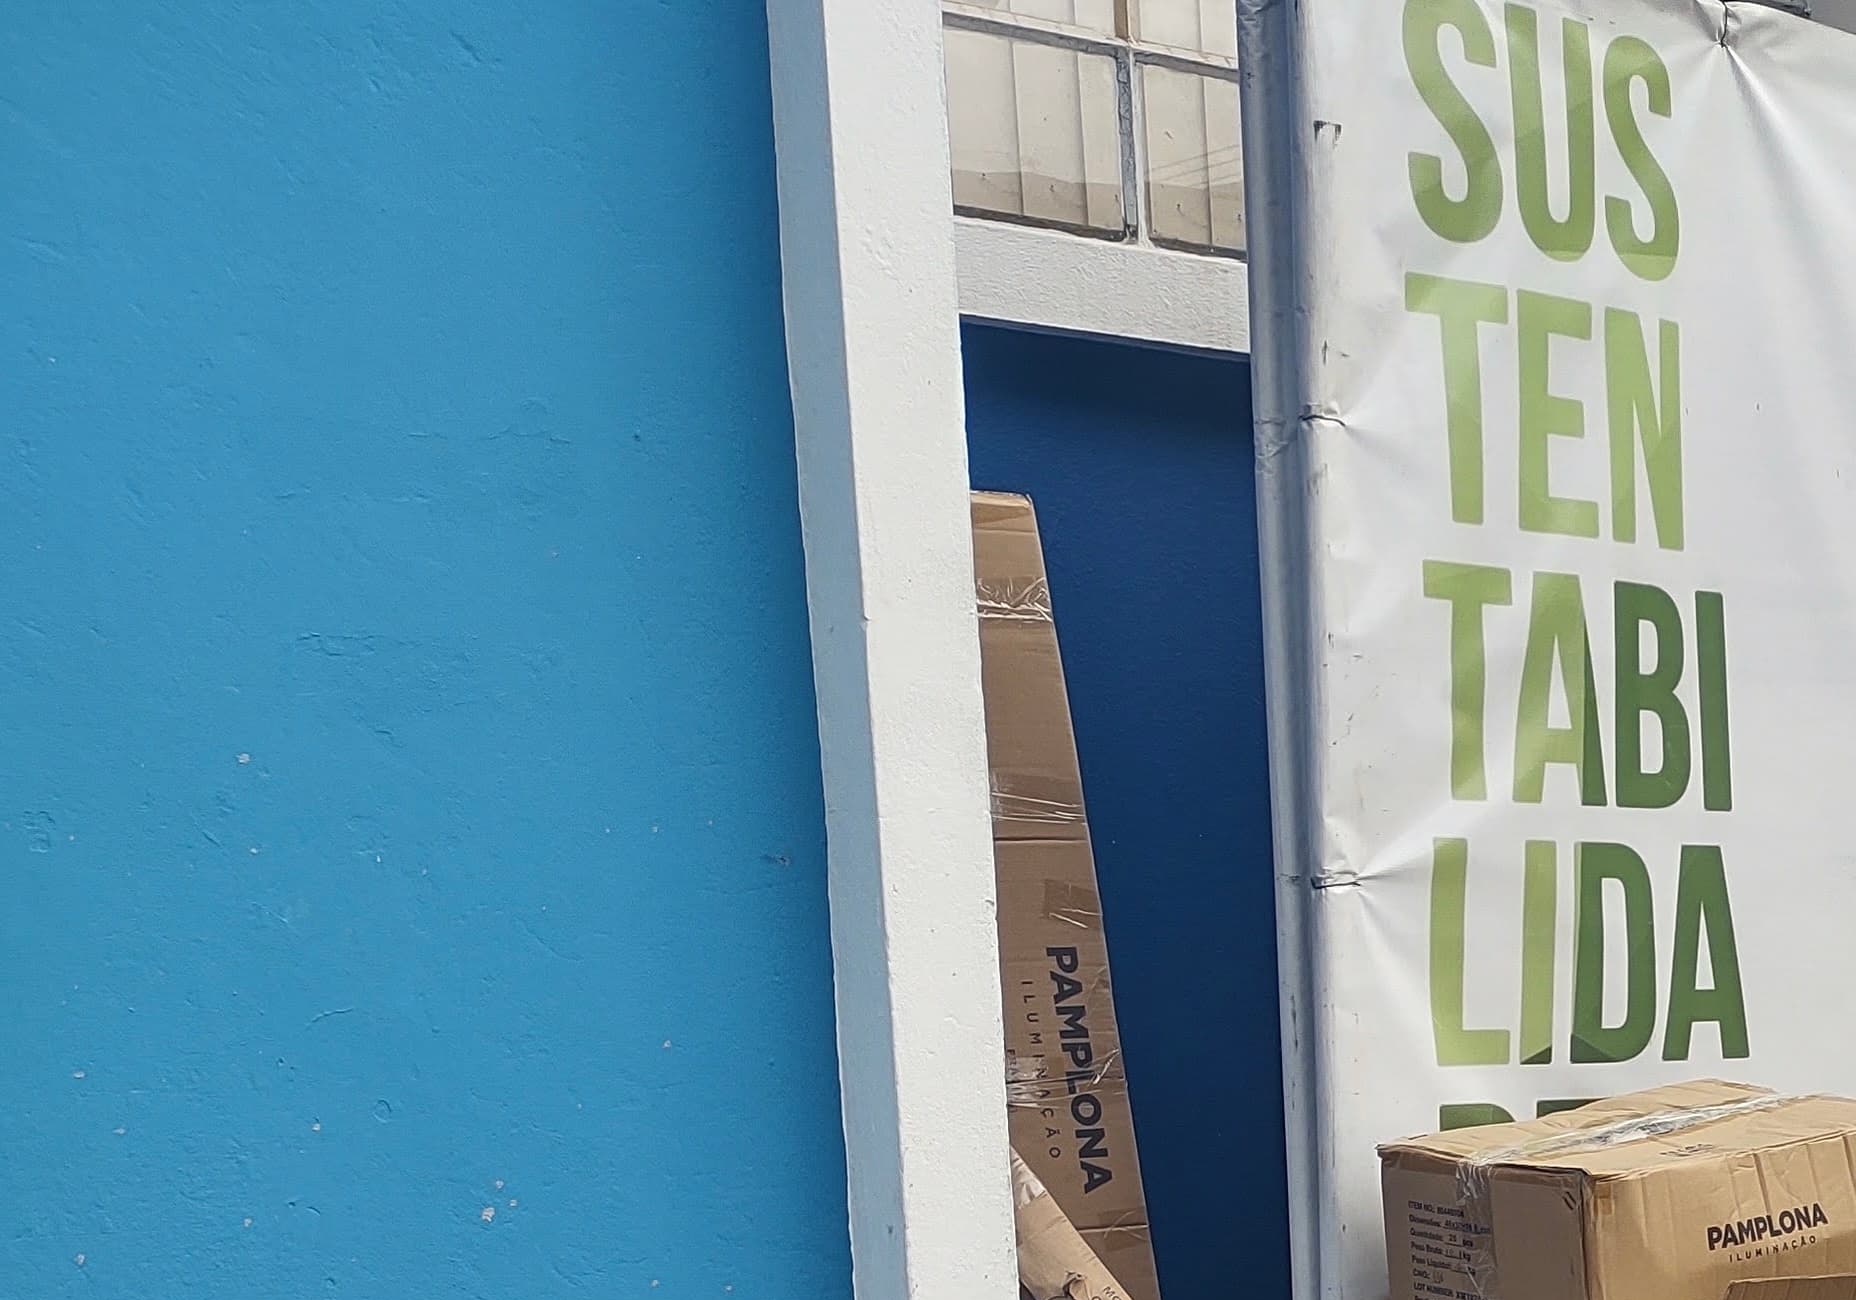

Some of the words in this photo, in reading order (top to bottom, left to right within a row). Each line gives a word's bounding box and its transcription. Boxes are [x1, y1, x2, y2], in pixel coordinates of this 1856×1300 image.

[1402, 0, 1680, 282] SUS
[1404, 272, 1686, 551] TEN
[1423, 560, 1733, 812] TABI
[1046, 946, 1113, 1194] PAMPLONA
[1429, 838, 1750, 1067] LIDA
[1706, 1202, 1829, 1251] PAMPLONA
[1729, 1235, 1817, 1263] ILUMINAÇÃO
